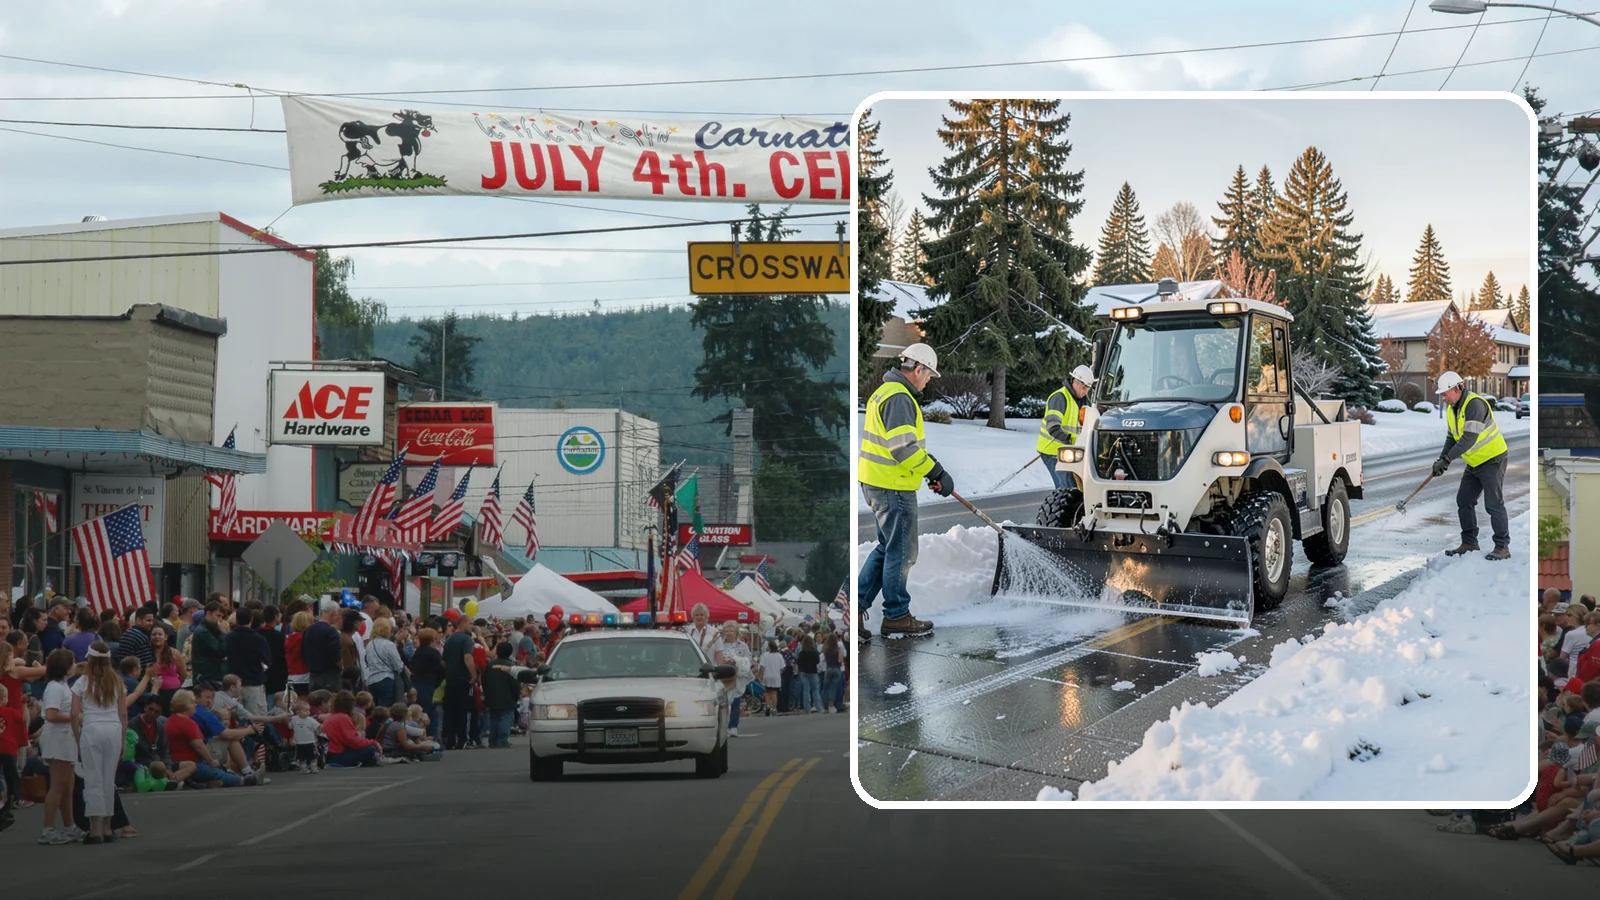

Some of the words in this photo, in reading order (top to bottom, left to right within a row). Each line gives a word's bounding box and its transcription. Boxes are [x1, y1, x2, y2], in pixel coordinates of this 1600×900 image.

[695, 121, 850, 149] Carnat
[481, 141, 605, 192] JULY
[632, 150, 746, 198] 4th.
[697, 254, 850, 280] CROSSWA
[282, 380, 373, 420] ACE
[406, 409, 452, 422] CEDAR
[461, 409, 485, 421] LOG
[283, 421, 370, 436] Hardware
[353, 467, 386, 480] Simpl
[96, 485, 124, 495] Vincent
[126, 486, 134, 495] de
[138, 486, 155, 495] Paul
